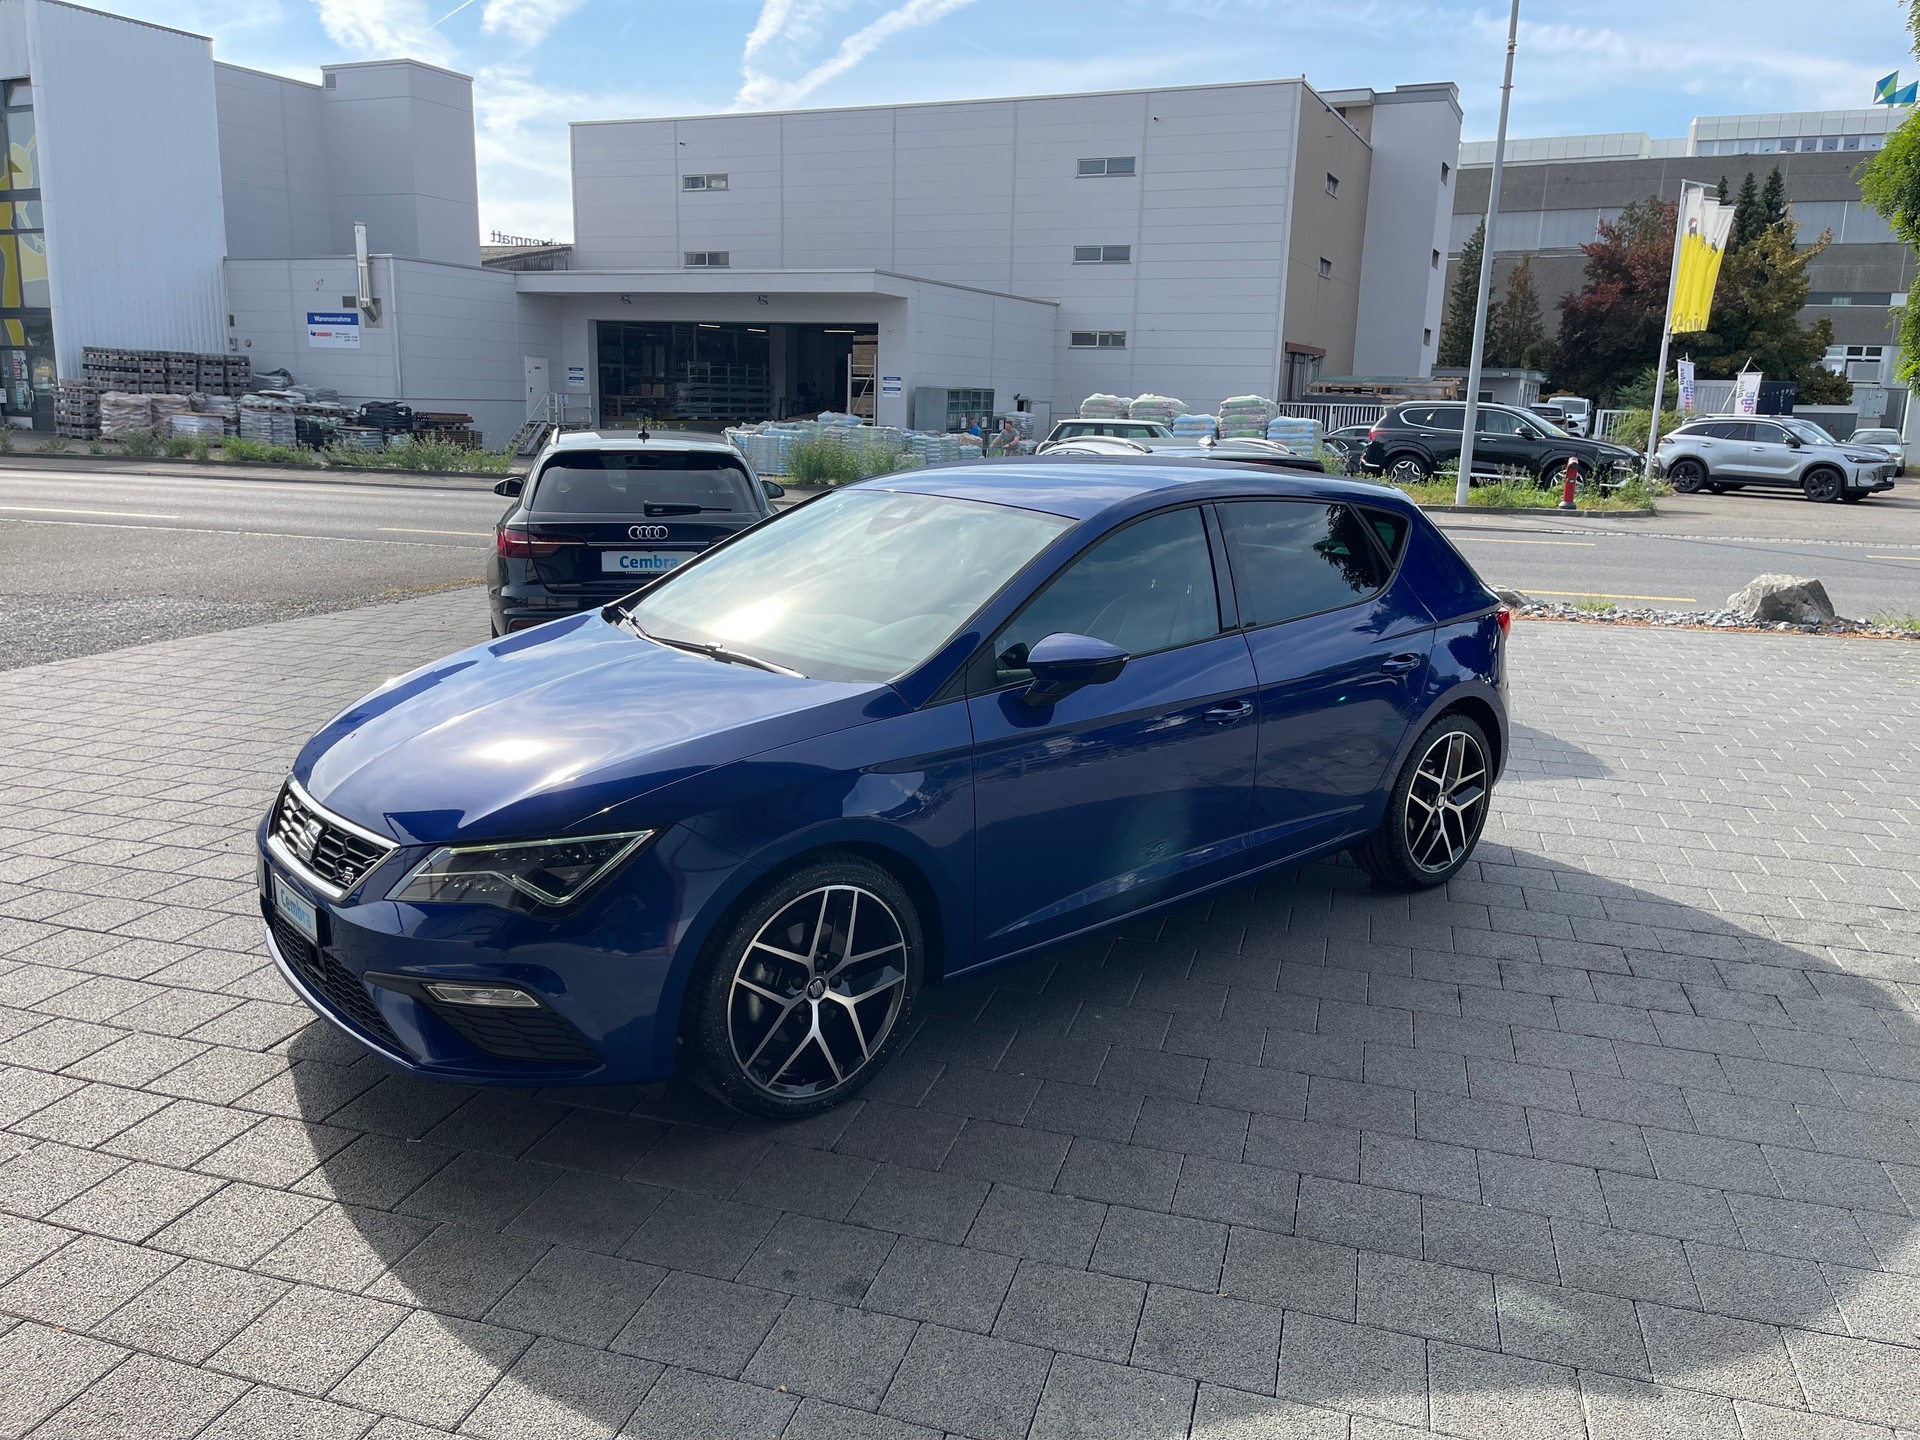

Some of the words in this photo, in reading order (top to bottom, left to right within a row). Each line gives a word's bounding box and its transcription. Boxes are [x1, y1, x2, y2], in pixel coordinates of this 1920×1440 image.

[313, 315, 352, 323] Warenannahme
[619, 555, 679, 569] Cembra
[280, 888, 312, 930] Cembra
